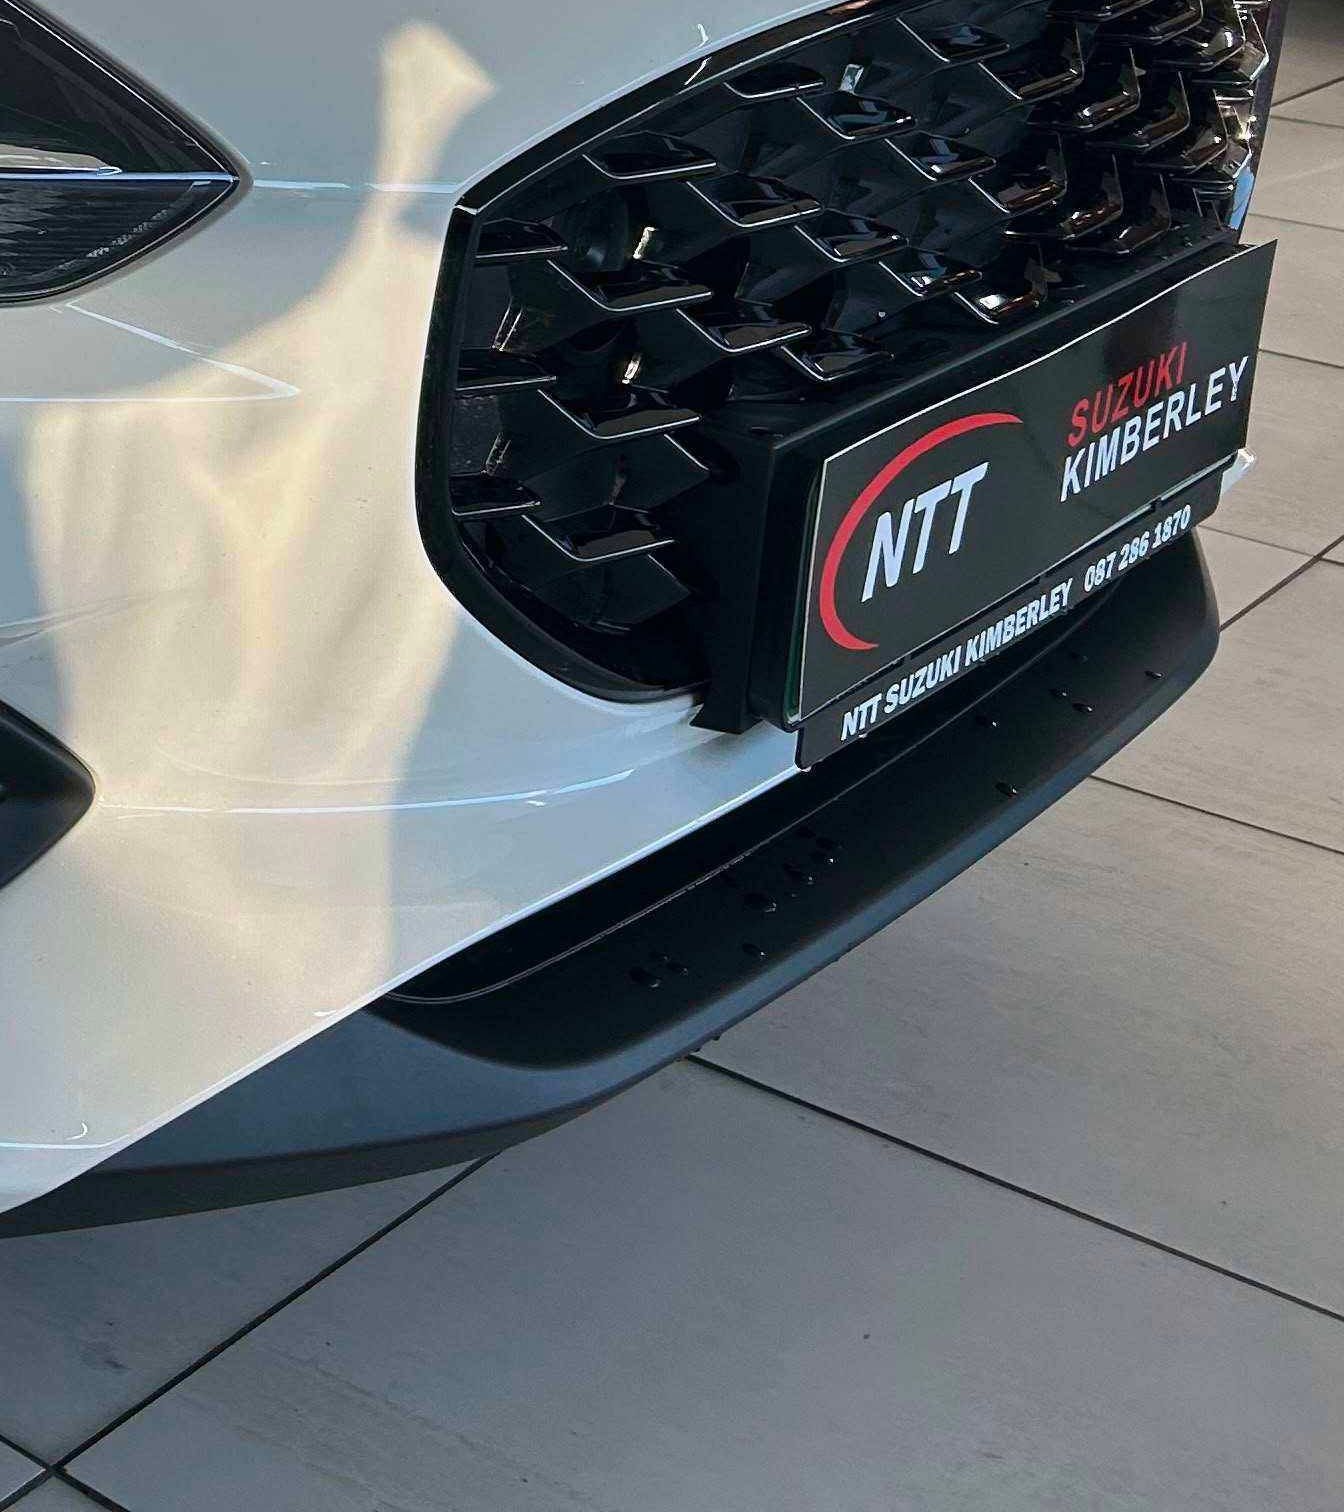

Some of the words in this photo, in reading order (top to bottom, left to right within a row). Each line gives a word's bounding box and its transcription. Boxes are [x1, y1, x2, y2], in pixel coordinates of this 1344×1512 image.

[1060, 355, 1249, 503] KIMBERLEY
[1067, 342, 1188, 448] SUZUKI
[861, 461, 989, 603] NTT
[840, 692, 883, 742] NTT
[883, 645, 962, 715] SUZUKI
[964, 577, 1074, 667] KIMBERLEY
[1083, 550, 1118, 593] 087
[1118, 530, 1151, 572] 286
[1151, 504, 1192, 550] 1870
